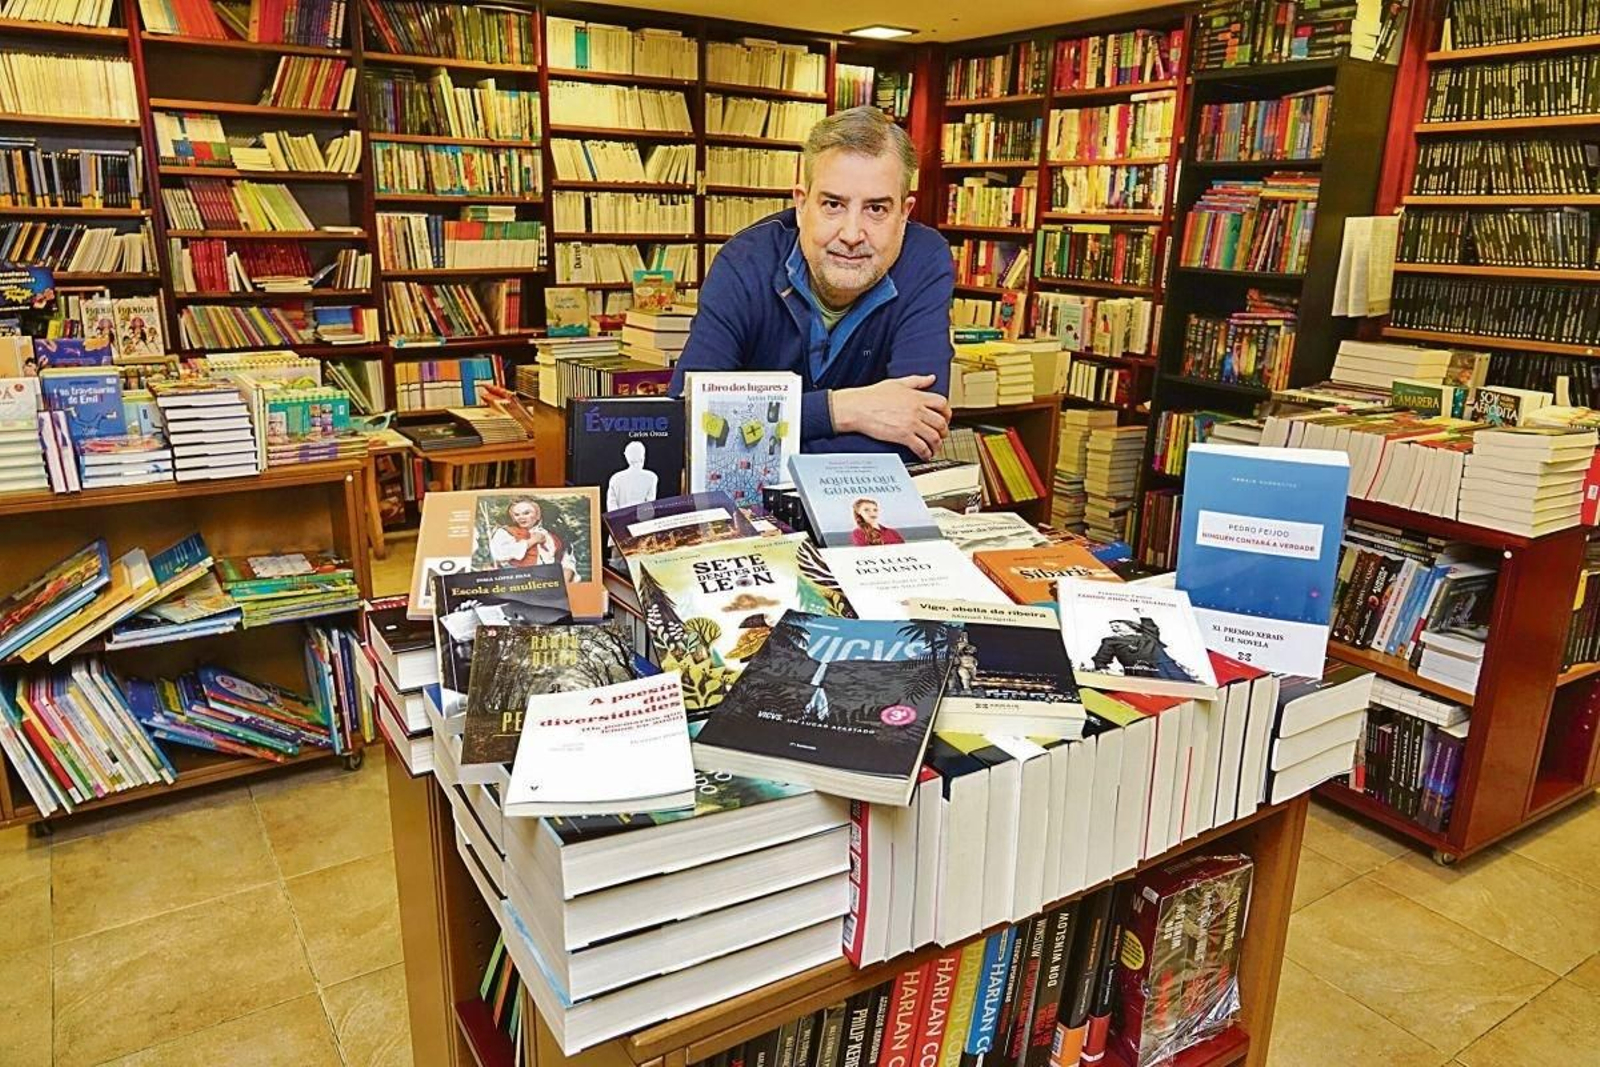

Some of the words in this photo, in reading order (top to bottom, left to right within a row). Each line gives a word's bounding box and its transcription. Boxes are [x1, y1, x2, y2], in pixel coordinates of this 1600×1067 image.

[702, 383, 729, 392] Libro
[729, 383, 746, 392] dos
[747, 382, 782, 394] lugares
[1480, 390, 1501, 403] SOY
[1393, 394, 1440, 409] CAMARERA
[584, 406, 670, 432] Évame
[819, 474, 871, 486] AQUELLO
[872, 475, 898, 484] QUE
[823, 485, 902, 495] GUARDAMOS
[1228, 523, 1257, 535] PEDRO
[1279, 542, 1315, 552] VERDADE
[692, 553, 765, 574] SETE
[856, 566, 879, 575] DO
[882, 564, 932, 573] VENTO
[697, 568, 751, 581] DENTES
[753, 564, 769, 572] DE
[452, 585, 490, 596] Escola
[491, 584, 506, 593] de
[508, 580, 559, 592] mulleres
[920, 603, 949, 611] Vigo,
[1008, 610, 1047, 618] ribeira
[1212, 624, 1222, 632] XL
[1223, 627, 1254, 637] PREMIO
[1256, 631, 1284, 641] XERAIS
[1224, 635, 1235, 643] DE
[1237, 637, 1269, 649] NOVELA
[588, 697, 604, 706] A
[612, 683, 679, 703] poesía
[643, 692, 680, 704] das
[539, 701, 681, 727] diversidades
[1031, 918, 1046, 956] WINSLOW
[1052, 912, 1068, 962] WINSLOW
[1047, 966, 1060, 986] DON
[925, 958, 954, 1036] HARLAN
[979, 963, 1004, 1031] HARLAN
[891, 971, 920, 1049] HARLAN
[849, 1008, 867, 1040] PHILIP
